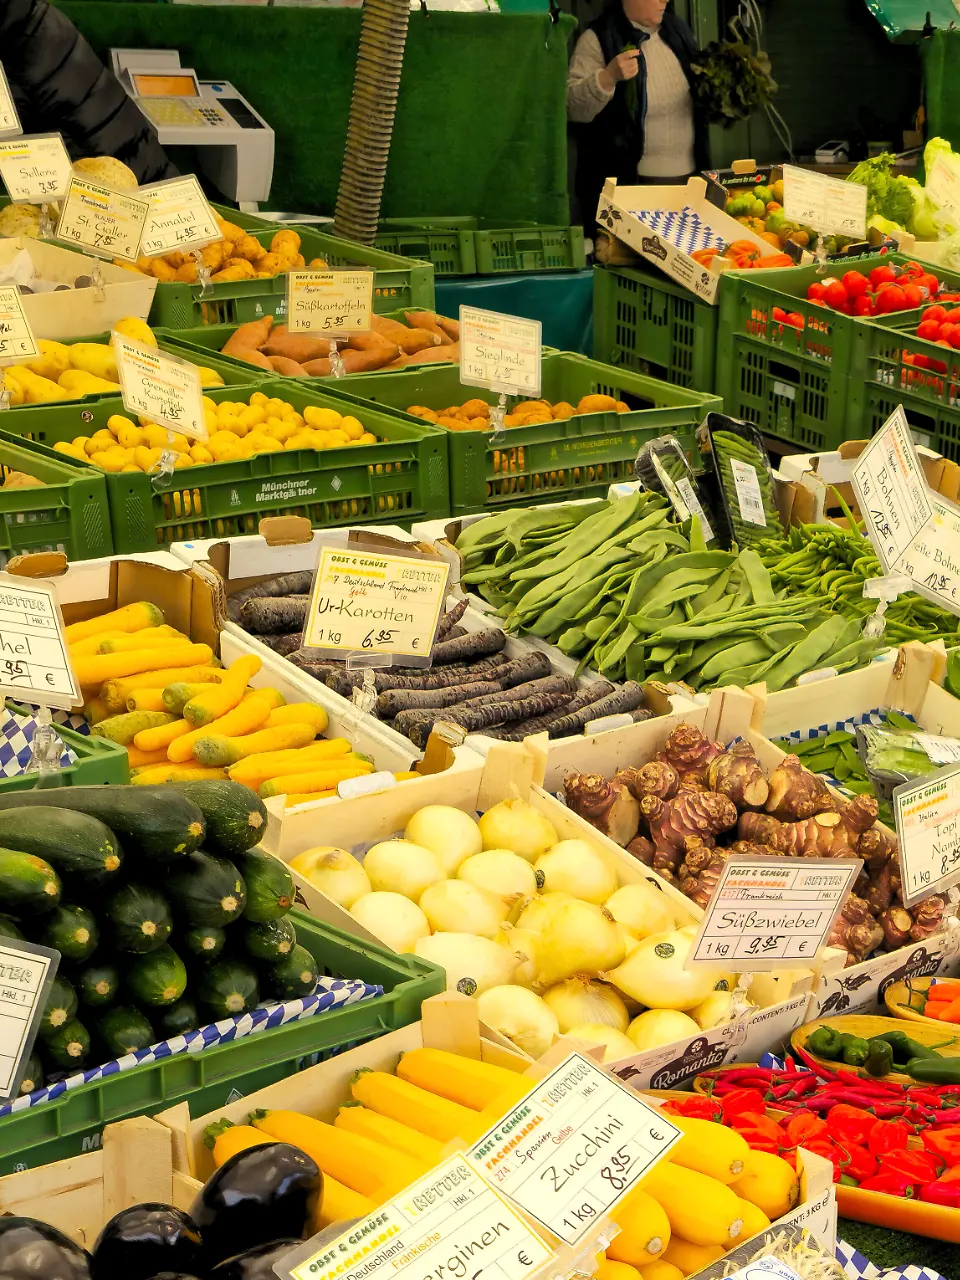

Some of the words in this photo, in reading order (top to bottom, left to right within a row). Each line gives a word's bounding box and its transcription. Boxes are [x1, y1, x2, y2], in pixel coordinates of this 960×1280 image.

[19, 166, 58, 179] Sellerie
[20, 187, 30, 195] kg
[76, 216, 92, 225] St.
[95, 222, 128, 238] Galler
[150, 211, 196, 231] Annabel
[71, 229, 81, 239] kg
[152, 240, 163, 249] kg
[295, 300, 366, 312] Süßkartoffeln
[300, 318, 311, 328] kg
[357, 318, 361, 326] €
[20, 343, 26, 351] €
[475, 345, 526, 366] Sieglinde
[473, 365, 483, 376] kg
[524, 375, 530, 384] €
[138, 397, 147, 410] kg
[144, 389, 185, 412] Kartoffeln
[262, 480, 309, 492] Münchner
[877, 467, 901, 529] Bohnen
[863, 480, 871, 496] kg
[888, 546, 893, 556] €
[332, 556, 350, 564] OBST
[360, 559, 388, 568] GEMÜSE
[905, 563, 914, 576] kg
[951, 588, 957, 597] €
[318, 598, 413, 622] Ur-Karotten
[320, 629, 324, 640] 1
[329, 630, 341, 644] kg
[362, 629, 400, 648] 6.95
[412, 638, 419, 648] €
[45, 673, 55, 685] €
[925, 782, 947, 797] GEMÜSE
[934, 818, 957, 837] Topi
[760, 869, 791, 877] GEMÜSE
[913, 875, 917, 886] 1
[920, 870, 930, 883] kg
[740, 889, 783, 900] Frankreich
[717, 911, 822, 933] Süßzwiebel
[707, 944, 711, 954] 1
[715, 943, 730, 956] kg
[745, 935, 786, 954] 9.95
[799, 941, 807, 952] €
[2, 989, 18, 1000] Hkl.
[654, 1052, 723, 1089] Romantic
[473, 1142, 496, 1161] OBST
[495, 1133, 503, 1141] &
[501, 1105, 532, 1134] GEMÜSE
[485, 1115, 545, 1171] FACHHANDEL
[494, 1166, 511, 1182] 274
[515, 1131, 553, 1165] Spanien
[552, 1124, 574, 1145] Gelbe
[540, 1114, 624, 1193] Zucchini
[563, 1218, 577, 1230] 1
[571, 1202, 597, 1222] kg
[601, 1145, 641, 1190] 8.95
[649, 1128, 665, 1141] €
[308, 1254, 336, 1274] OBST
[338, 1242, 348, 1253] &
[348, 1212, 390, 1245] GEMÜSE
[391, 1231, 442, 1270] Fränkische
[516, 1249, 534, 1269] €
